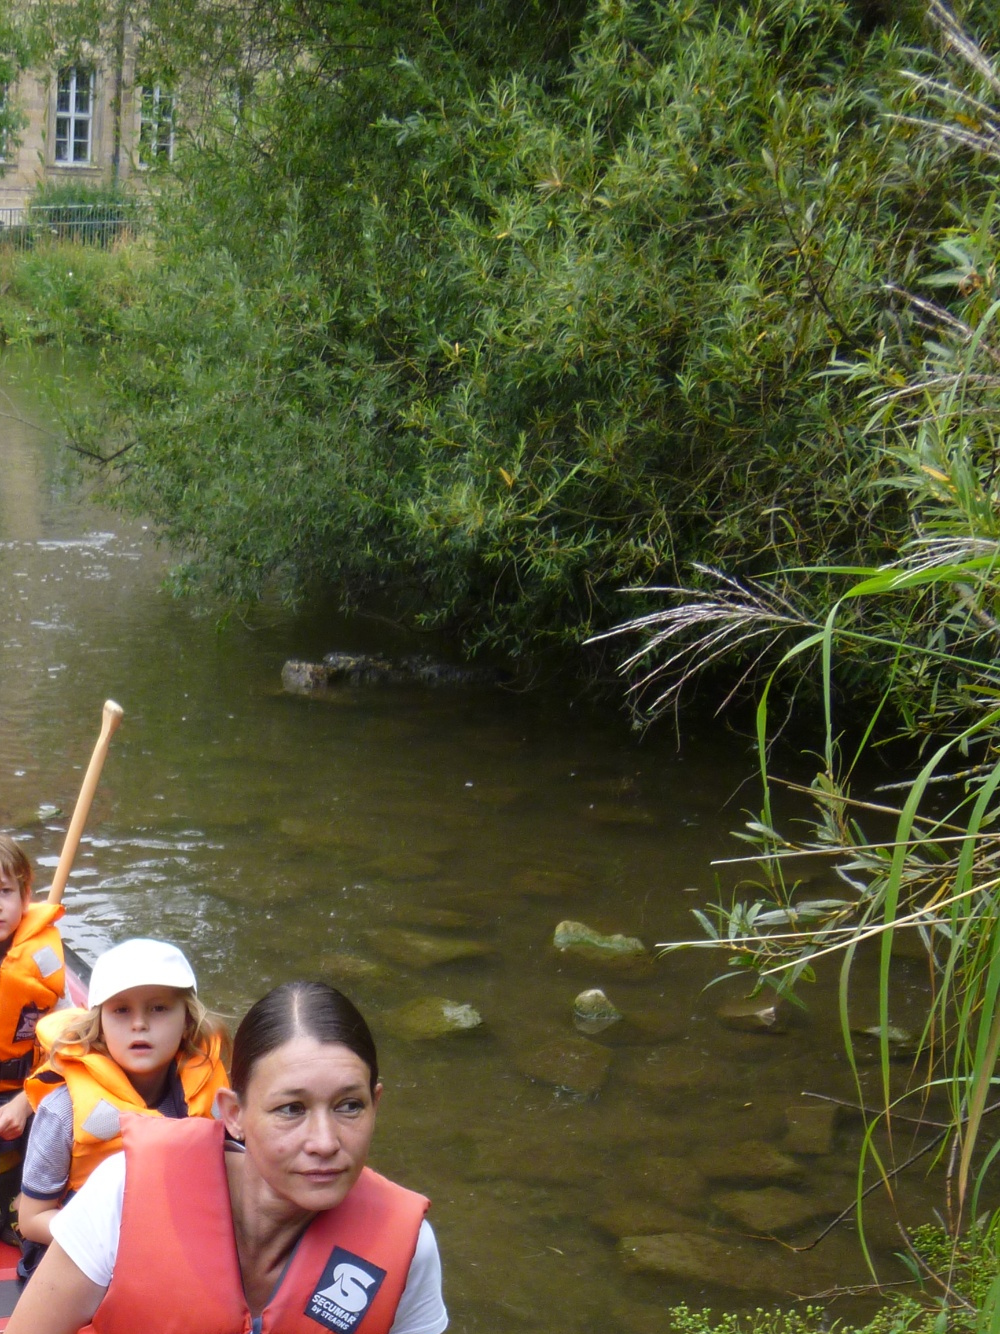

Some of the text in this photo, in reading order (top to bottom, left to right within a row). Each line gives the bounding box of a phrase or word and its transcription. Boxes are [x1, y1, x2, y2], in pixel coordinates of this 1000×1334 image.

[311, 1294, 357, 1325] SECUMAR
[311, 1304, 350, 1331] by STEARNS
